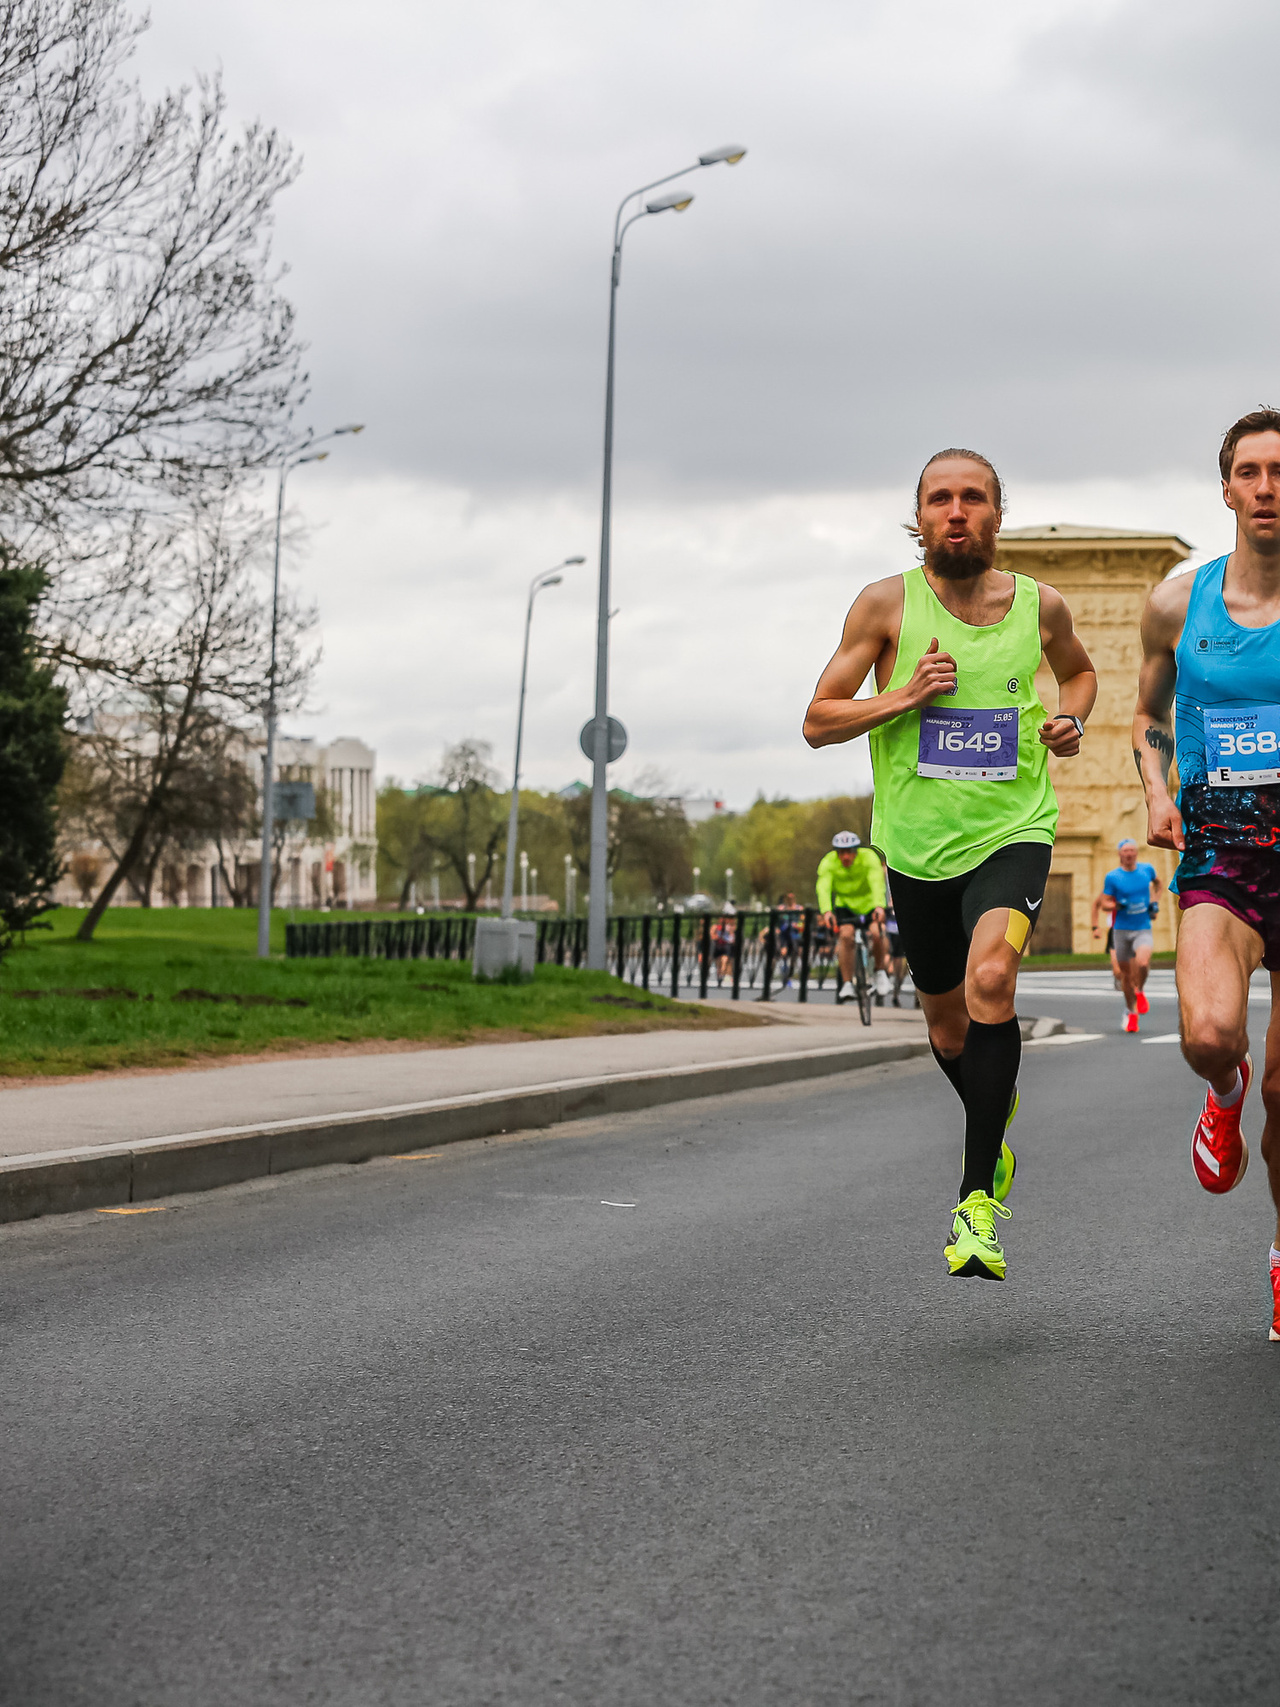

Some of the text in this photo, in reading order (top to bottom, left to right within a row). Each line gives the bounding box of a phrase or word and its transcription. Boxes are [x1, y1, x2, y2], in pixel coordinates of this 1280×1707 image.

[993, 712, 1014, 722] 15.05
[938, 730, 1002, 752] 1649
[1220, 769, 1230, 782] E
